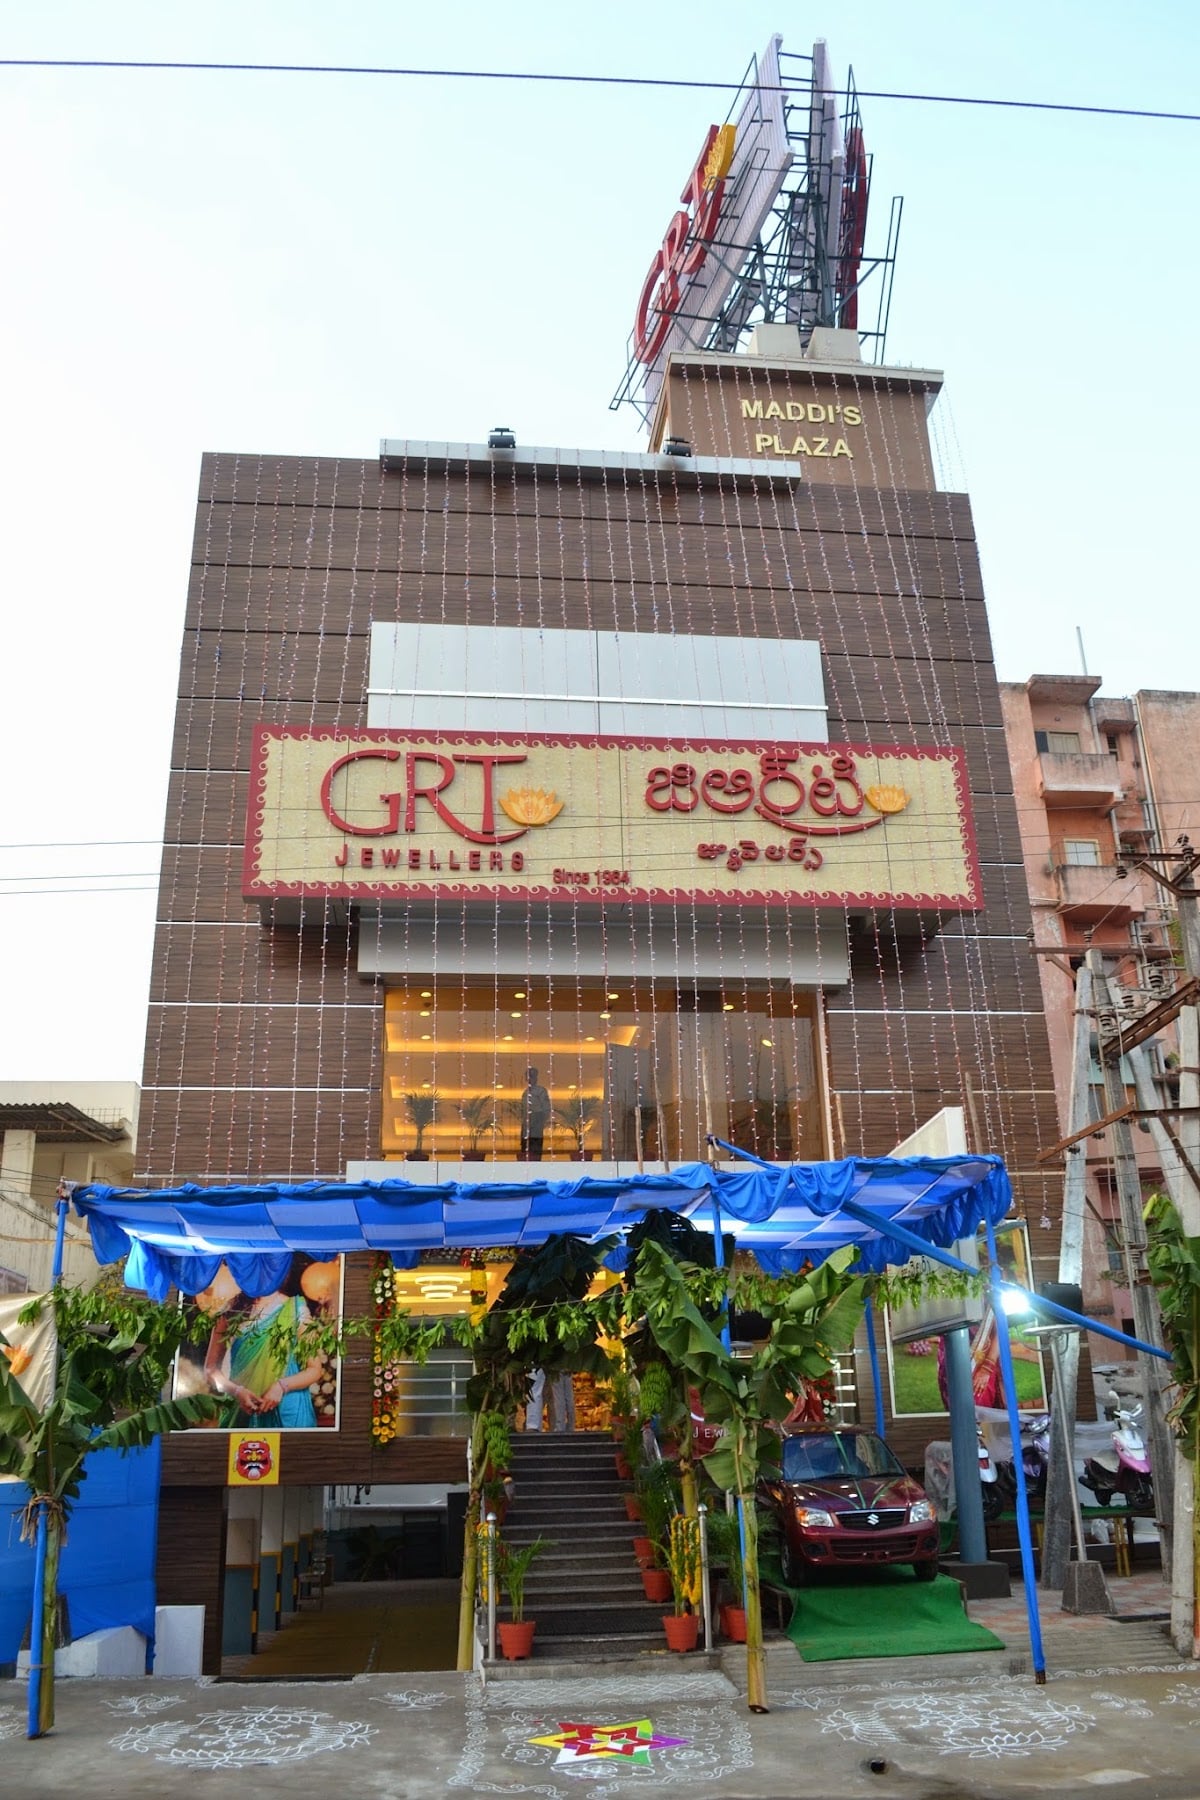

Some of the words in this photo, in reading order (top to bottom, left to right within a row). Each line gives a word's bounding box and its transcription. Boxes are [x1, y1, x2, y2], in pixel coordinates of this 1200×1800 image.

[740, 399, 863, 427] MADDI'S
[754, 432, 854, 459] PLAZA
[320, 748, 529, 846] GRT
[334, 843, 525, 872] JEWELLERS
[552, 867, 590, 885] Since
